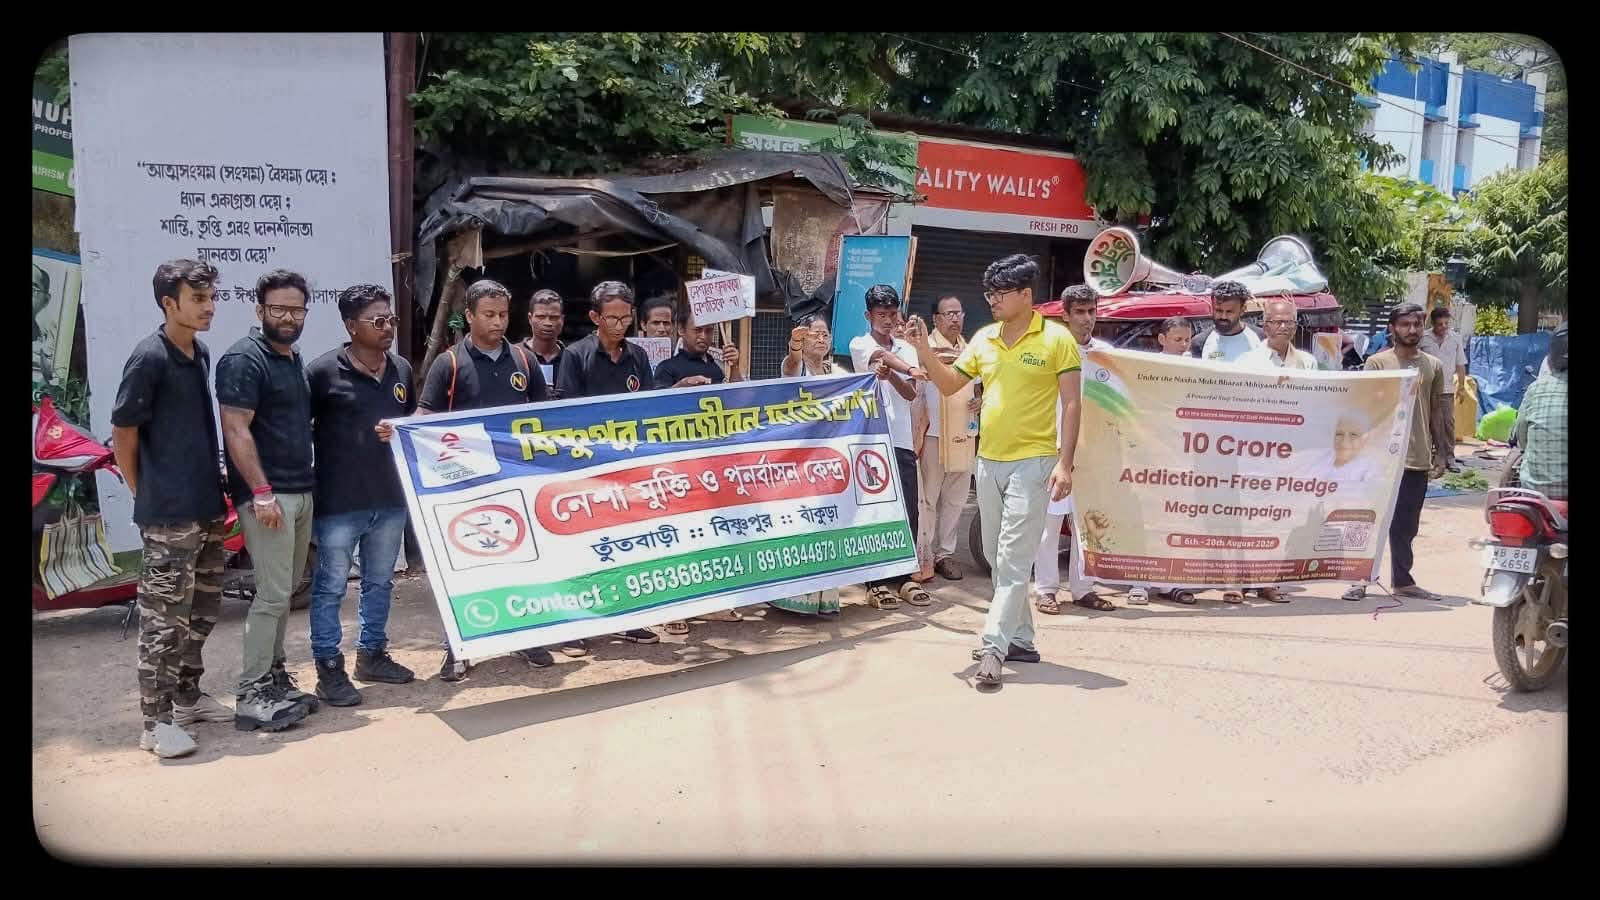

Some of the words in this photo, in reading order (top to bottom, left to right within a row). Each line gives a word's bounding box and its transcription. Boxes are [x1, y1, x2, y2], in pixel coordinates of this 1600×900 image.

[226, 220, 250, 239] এবং
[254, 215, 313, 237] দানশীলতা
[1029, 220, 1057, 232] FRESH
[1060, 223, 1079, 234] PRO
[1182, 431, 1209, 454] 10
[1216, 435, 1293, 459] Crore
[551, 483, 631, 522] নেশা
[633, 466, 691, 510] মুক্তি
[697, 469, 719, 493] ও
[724, 455, 801, 496] পুনর্বাসন
[803, 457, 845, 483] কেন্দ্র
[1120, 468, 1272, 490] Addiction-Free
[1276, 477, 1338, 497] Pledge
[1164, 500, 1208, 519] Mega
[1213, 503, 1291, 521] Campaign
[710, 512, 773, 537] বিষ্ণুপুর
[505, 584, 604, 618] Contact
[626, 555, 744, 598] 9563685524
[757, 540, 837, 572] 8918344873
[843, 531, 907, 557] 8240084302
